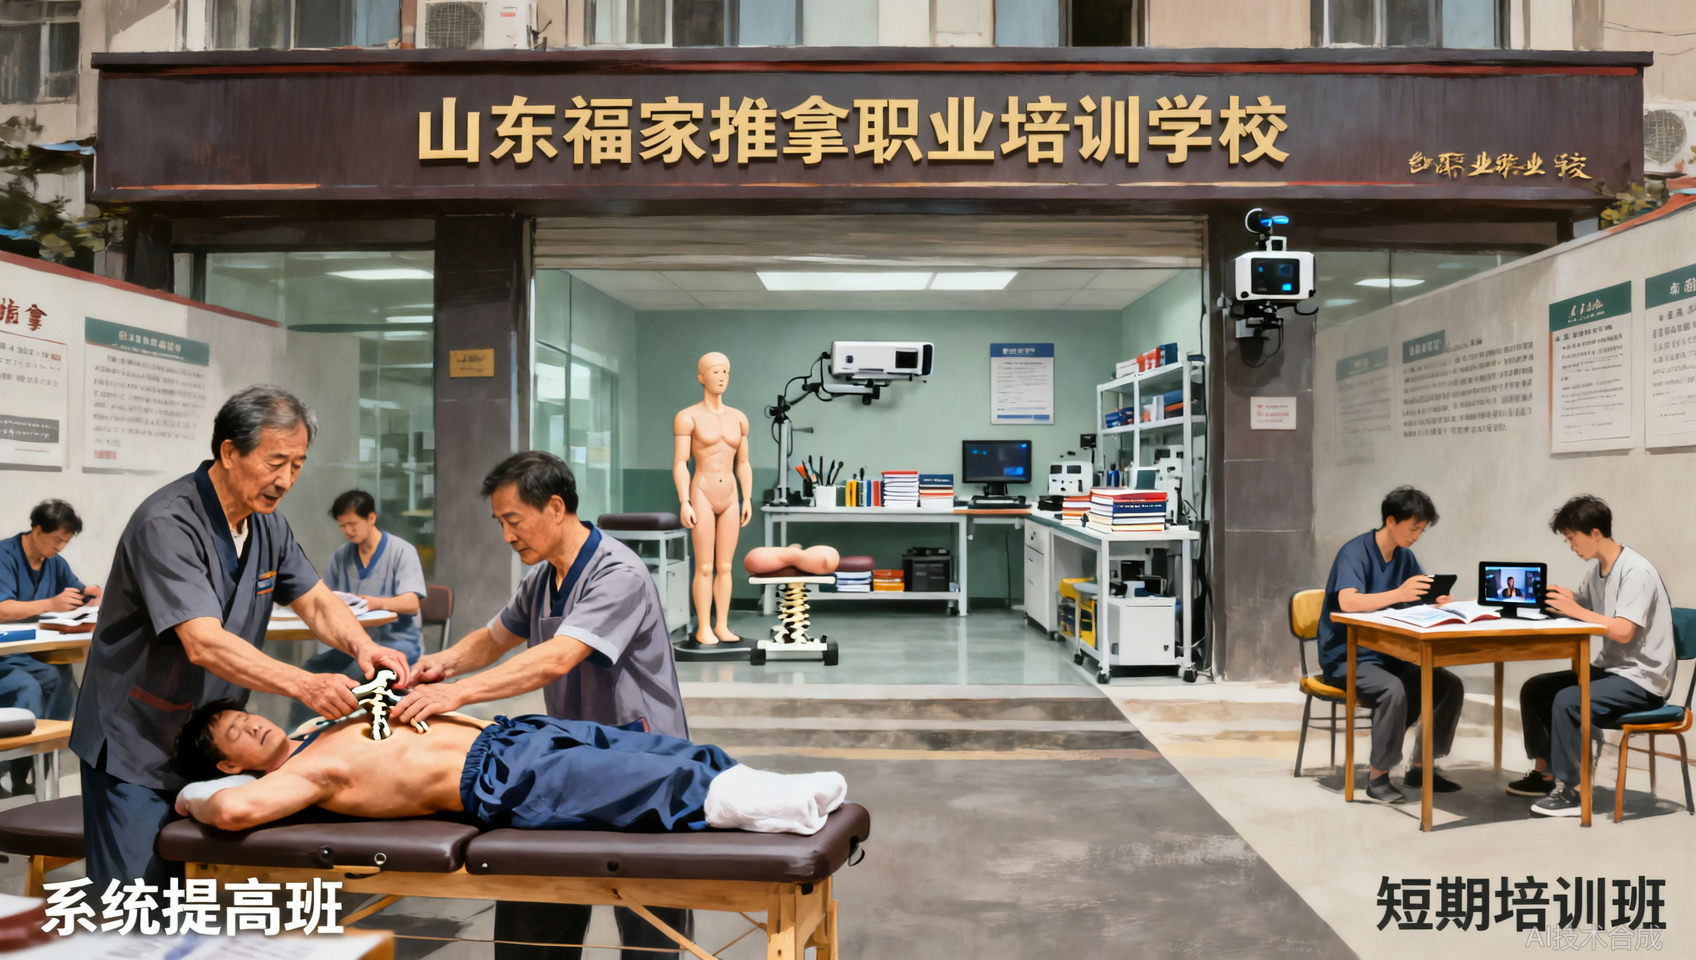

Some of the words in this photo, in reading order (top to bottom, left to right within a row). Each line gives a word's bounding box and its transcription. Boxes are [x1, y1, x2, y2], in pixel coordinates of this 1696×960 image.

[417, 94, 1291, 166] 山东福家推拿职业培训学校
